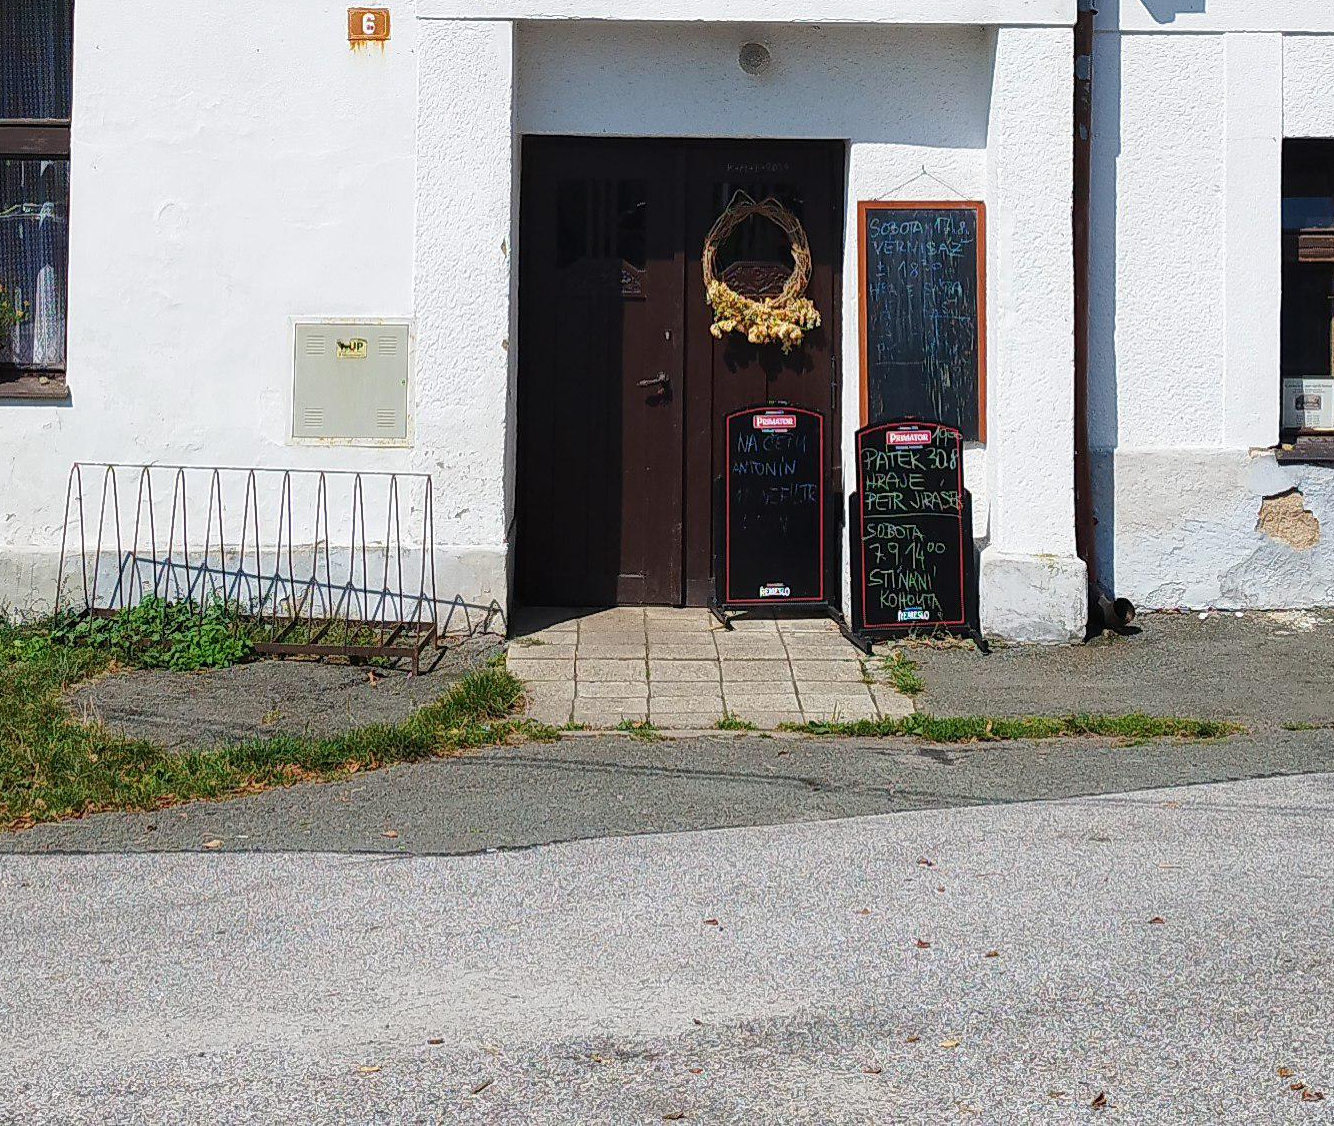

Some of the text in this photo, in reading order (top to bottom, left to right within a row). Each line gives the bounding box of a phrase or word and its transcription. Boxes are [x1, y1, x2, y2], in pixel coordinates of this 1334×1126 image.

[362, 12, 376, 35] 6
[869, 217, 924, 238] SOBOTA
[866, 472, 926, 491] HRAJE
[865, 491, 908, 511] PETR
[862, 522, 925, 542] SOBOTA
